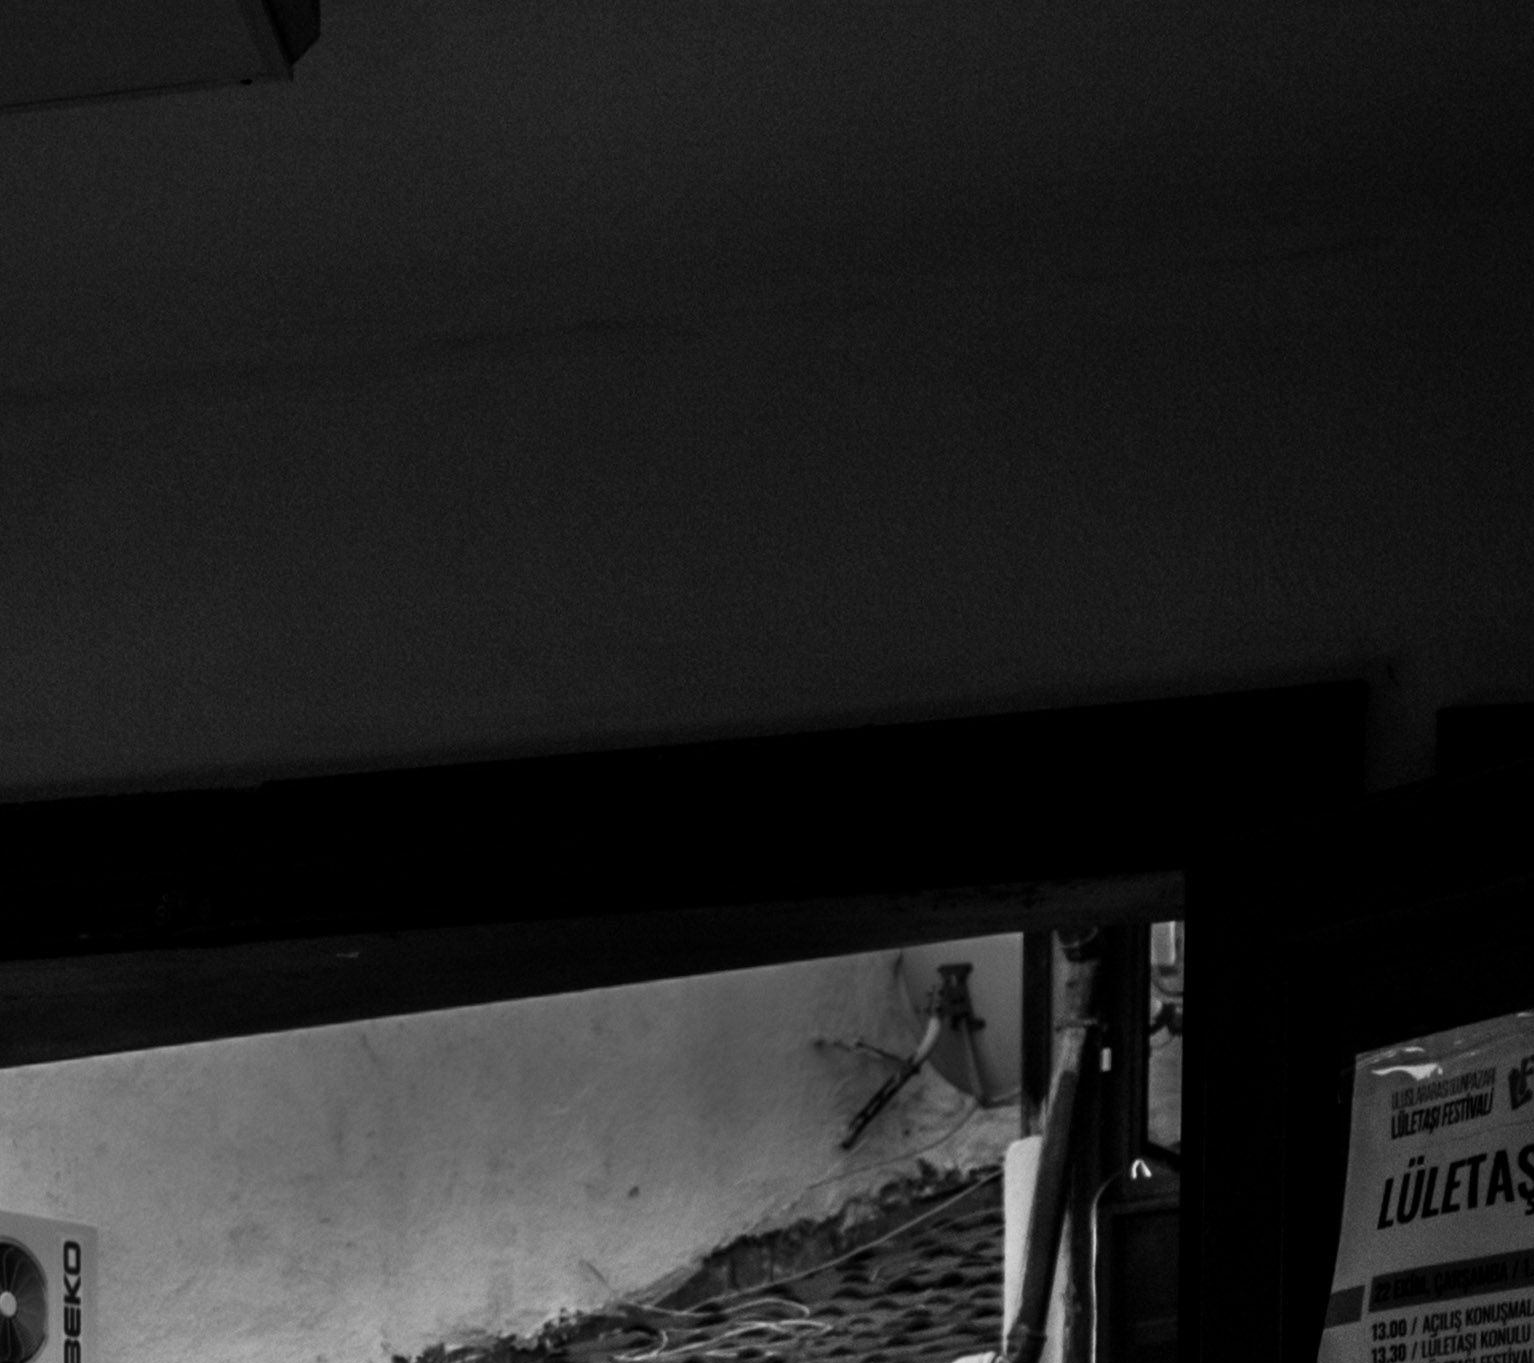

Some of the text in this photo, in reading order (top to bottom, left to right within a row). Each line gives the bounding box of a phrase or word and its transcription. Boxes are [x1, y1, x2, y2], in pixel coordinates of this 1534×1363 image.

[1374, 1282, 1390, 1302] 22
[1435, 1262, 1508, 1298] ÇARŞAMBA
[1372, 1318, 1407, 1341] 13.00
[1423, 1310, 1462, 1338] AÇILIŞ
[1422, 1332, 1476, 1359] LÜLETAŞI
[1481, 1324, 1531, 1348] KONULU
